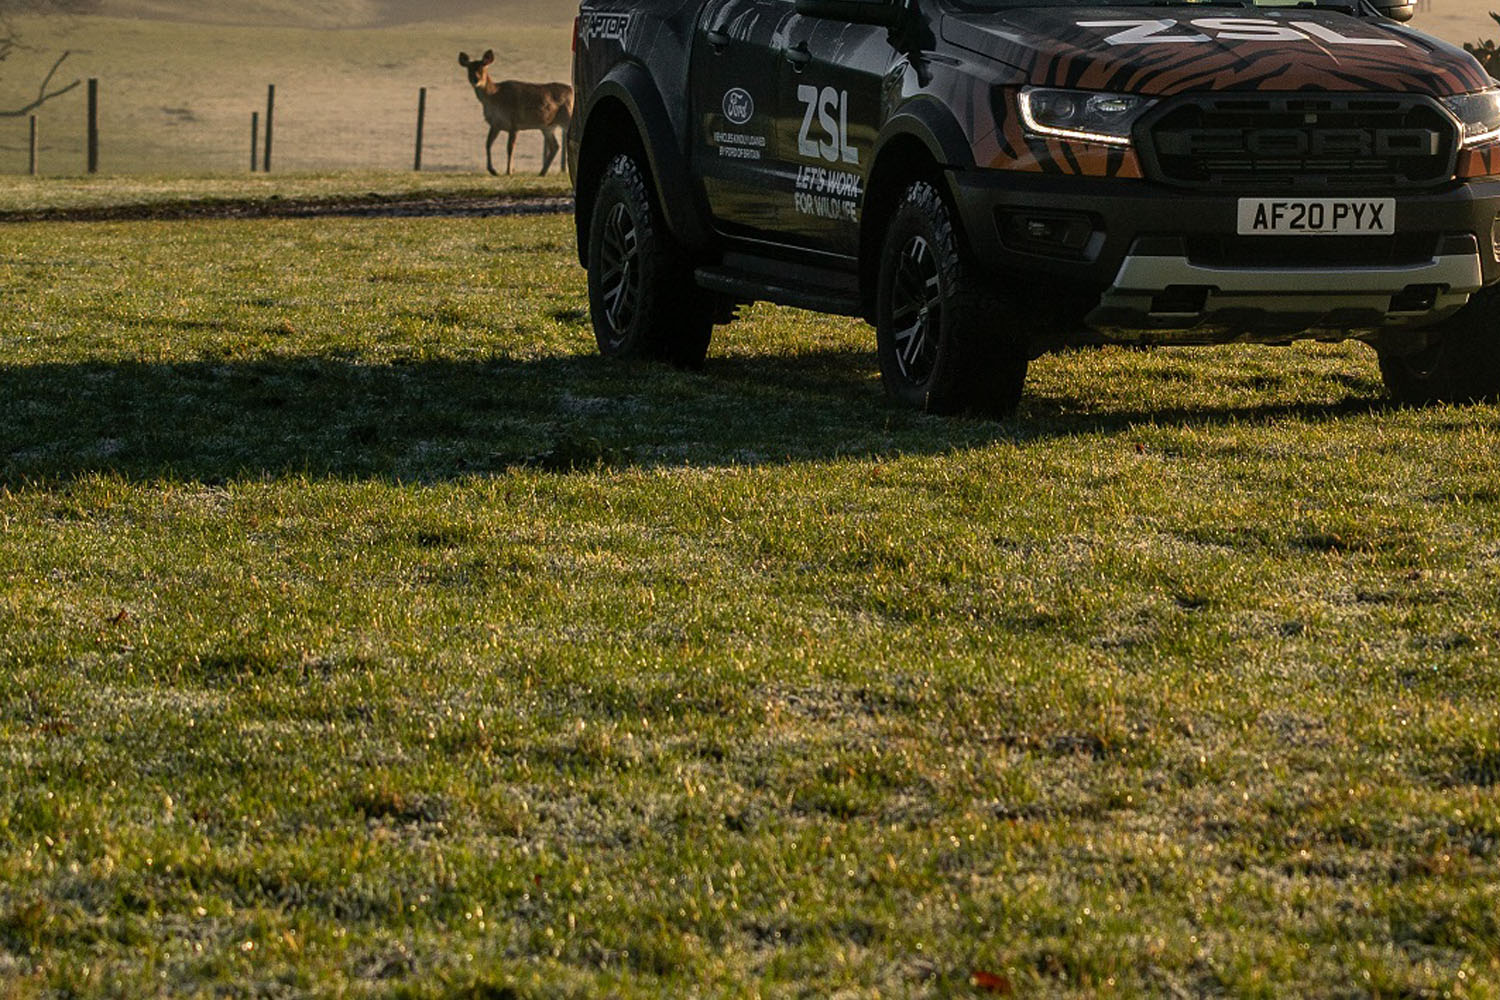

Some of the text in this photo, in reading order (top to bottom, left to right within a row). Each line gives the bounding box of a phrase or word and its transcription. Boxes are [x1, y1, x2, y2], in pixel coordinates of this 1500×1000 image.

[579, 12, 630, 52] RAPTOR
[1076, 18, 1407, 47] ZSL
[728, 92, 748, 118] Ford
[797, 84, 859, 164] ZSL
[1155, 128, 1439, 155] FORD
[796, 166, 860, 198] LET'S WORK
[795, 191, 857, 223] FOR WILDLIFE
[1253, 203, 1384, 229] AF20 PYX
